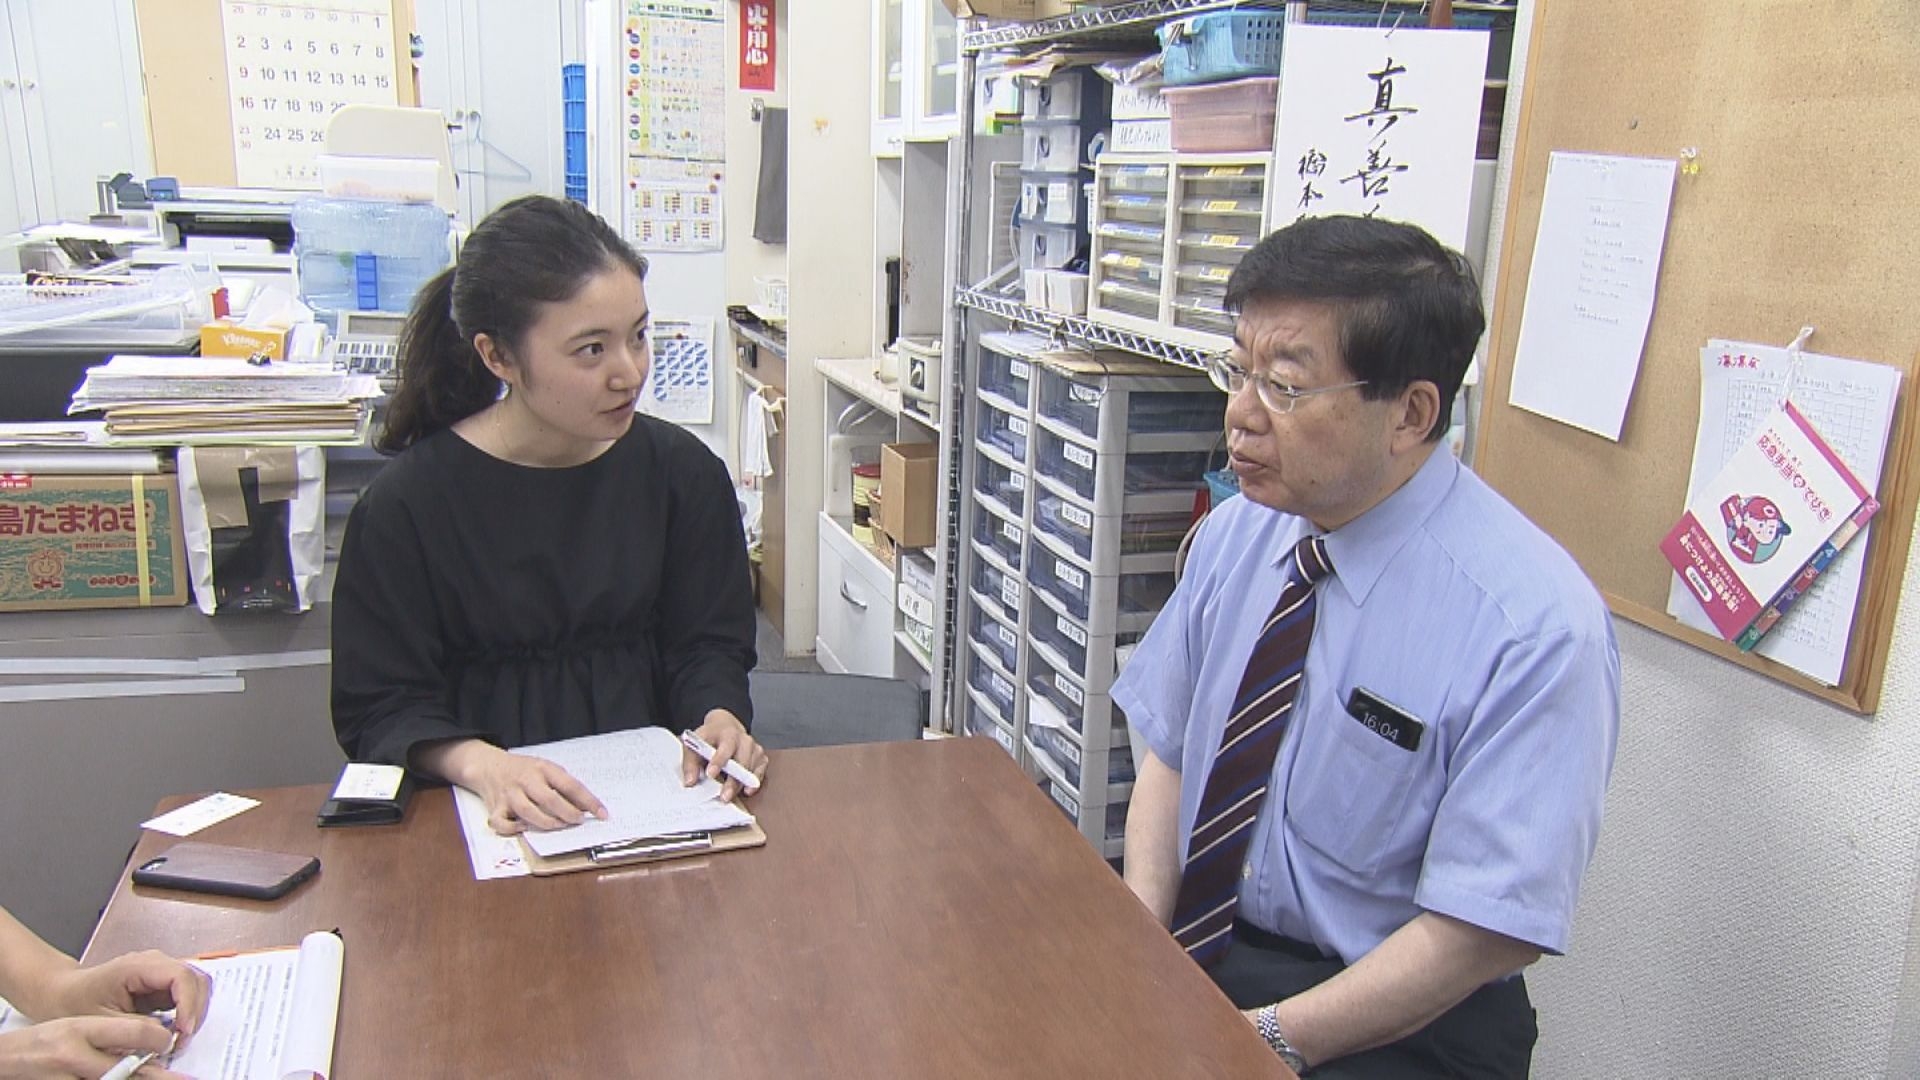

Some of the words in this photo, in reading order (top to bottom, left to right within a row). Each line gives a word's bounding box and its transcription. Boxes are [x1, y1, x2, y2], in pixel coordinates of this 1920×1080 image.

[375, 16, 380, 28] 1
[237, 35, 246, 48] 2
[261, 37, 269, 50] 3
[284, 39, 293, 51] 4
[308, 41, 316, 54] 5
[331, 43, 339, 55] 6
[353, 45, 361, 56] 7
[376, 46, 384, 58] 8
[240, 66, 248, 78] 9
[261, 67, 275, 81] 10
[283, 70, 297, 83] 11
[307, 71, 321, 84] 12
[330, 73, 344, 86] 13
[352, 74, 366, 87] 14
[375, 75, 388, 88] 15
[240, 96, 254, 109] 16
[262, 98, 277, 111] 17
[286, 99, 300, 112] 18
[309, 101, 323, 114] 19
[264, 127, 280, 140] 24
[288, 129, 304, 142] 25
[1340, 57, 1418, 219] 真善
[1363, 712, 1400, 741] 16:04
